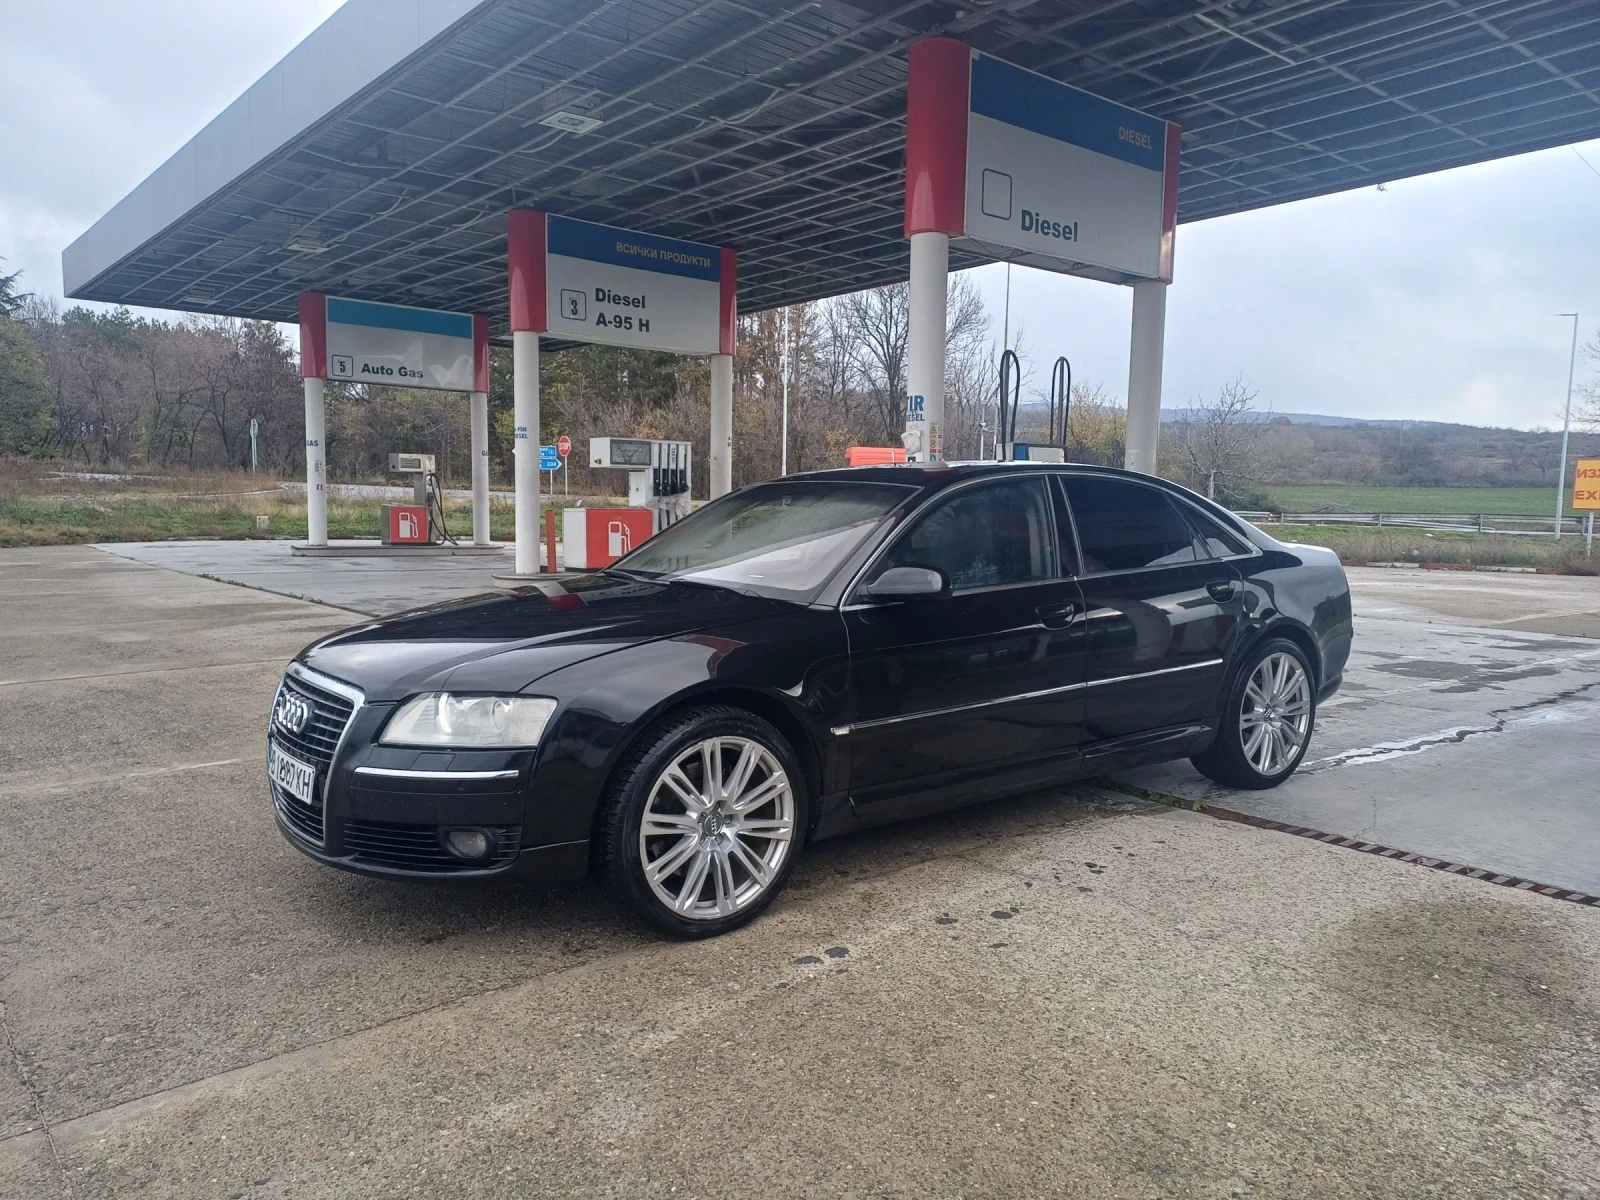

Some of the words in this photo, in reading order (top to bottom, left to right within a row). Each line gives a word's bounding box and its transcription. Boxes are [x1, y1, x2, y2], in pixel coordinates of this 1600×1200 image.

[1119, 126, 1153, 149] DIESEL
[1021, 209, 1078, 242] Diesel
[616, 242, 658, 259] ВСИЧКИ
[660, 250, 711, 268] ПРОДУКТИ
[571, 299, 578, 316] 3
[595, 287, 646, 309] Diesel
[595, 312, 633, 330] A-95
[638, 318, 650, 333] H
[340, 361, 346, 373] 5
[361, 363, 394, 376] Auto
[398, 366, 424, 379] Gas
